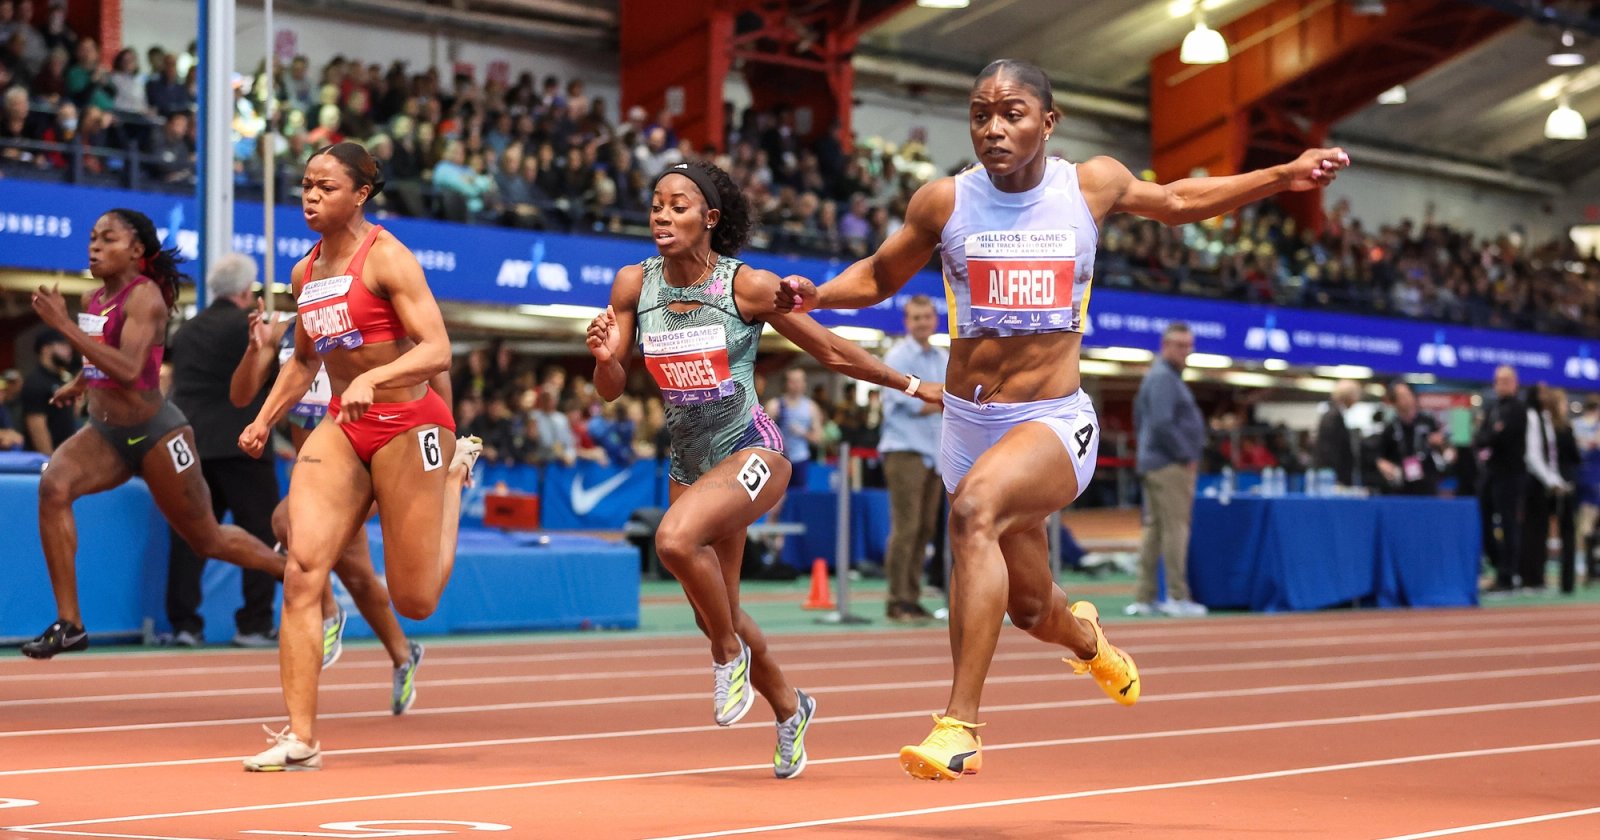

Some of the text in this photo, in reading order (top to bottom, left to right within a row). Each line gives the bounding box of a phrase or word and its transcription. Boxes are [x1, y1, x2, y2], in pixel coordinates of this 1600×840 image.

[976, 233, 1068, 242] MILLROSE GAMES
[988, 269, 1055, 306] ALFRED
[686, 328, 719, 338] GAMES
[659, 358, 717, 388] FORBES
[173, 439, 190, 466] 8
[424, 432, 439, 466] 6
[1074, 423, 1094, 460] 4
[743, 458, 768, 491] 5
